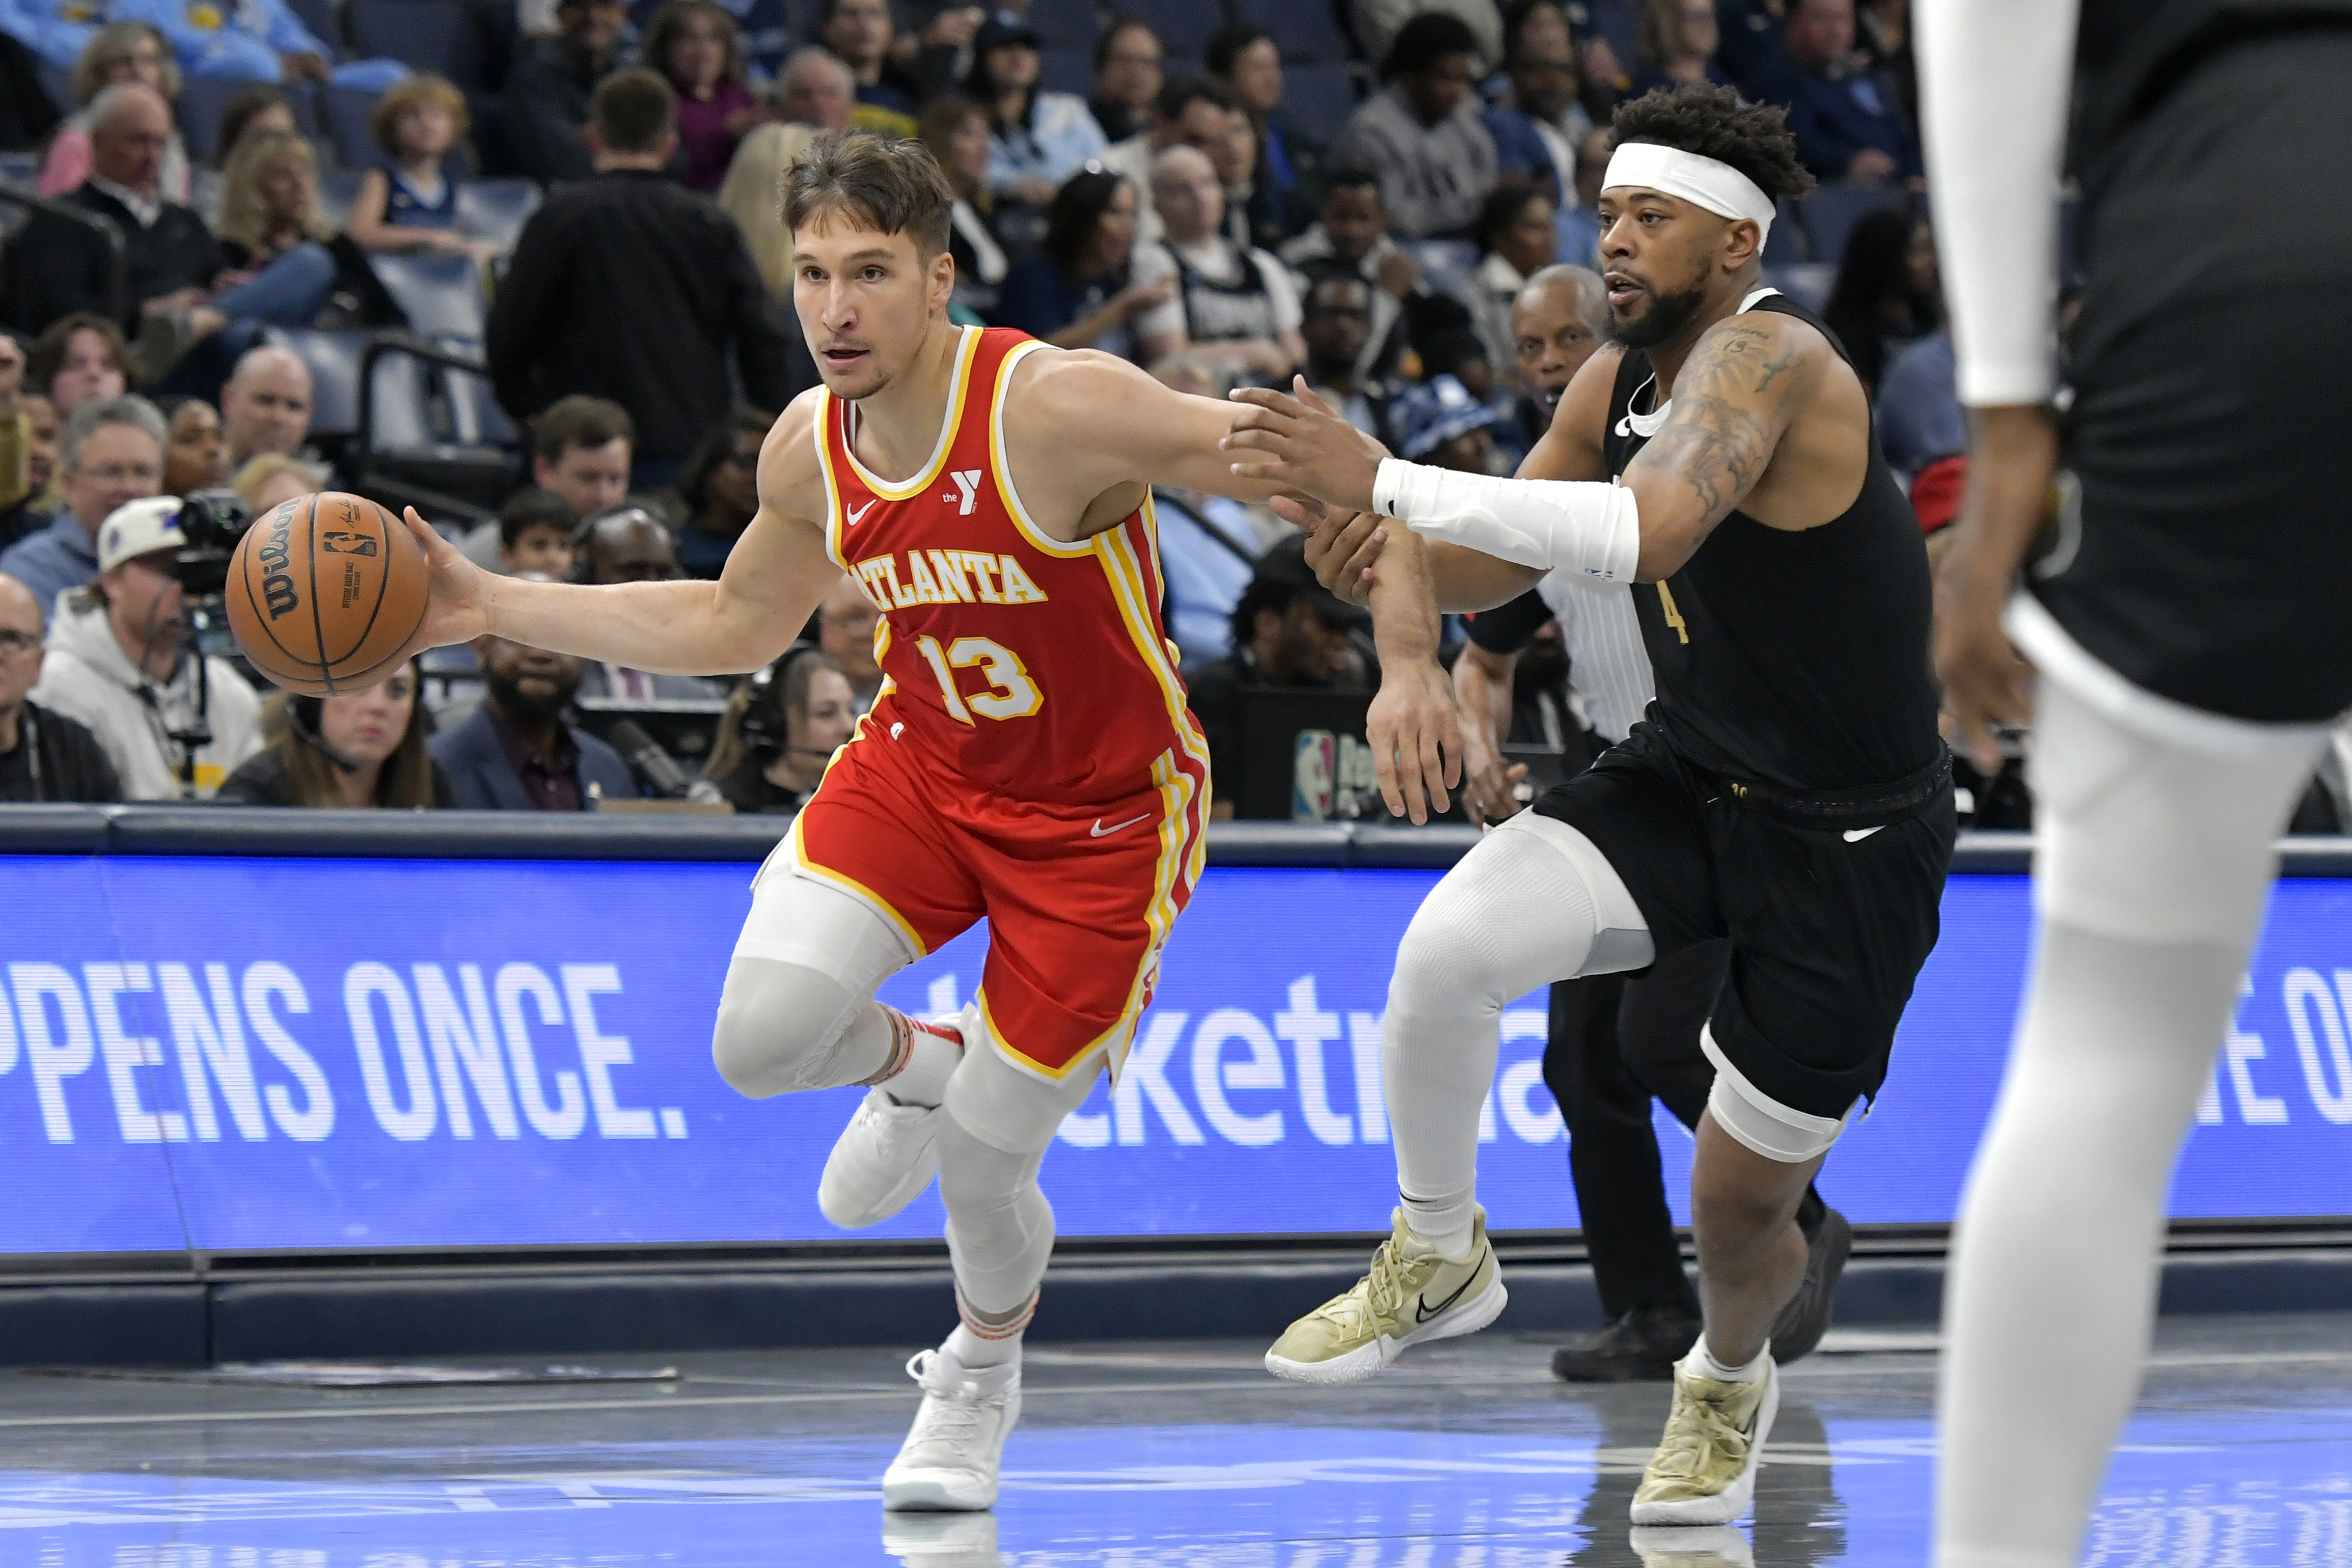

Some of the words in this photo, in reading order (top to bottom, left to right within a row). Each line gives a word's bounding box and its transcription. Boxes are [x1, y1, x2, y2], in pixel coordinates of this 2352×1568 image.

[942, 492, 958, 503] the
[950, 469, 982, 515] Y
[259, 499, 301, 622] Wilson
[915, 635, 1044, 727] 13
[343, 960, 689, 1142] ONCE.
